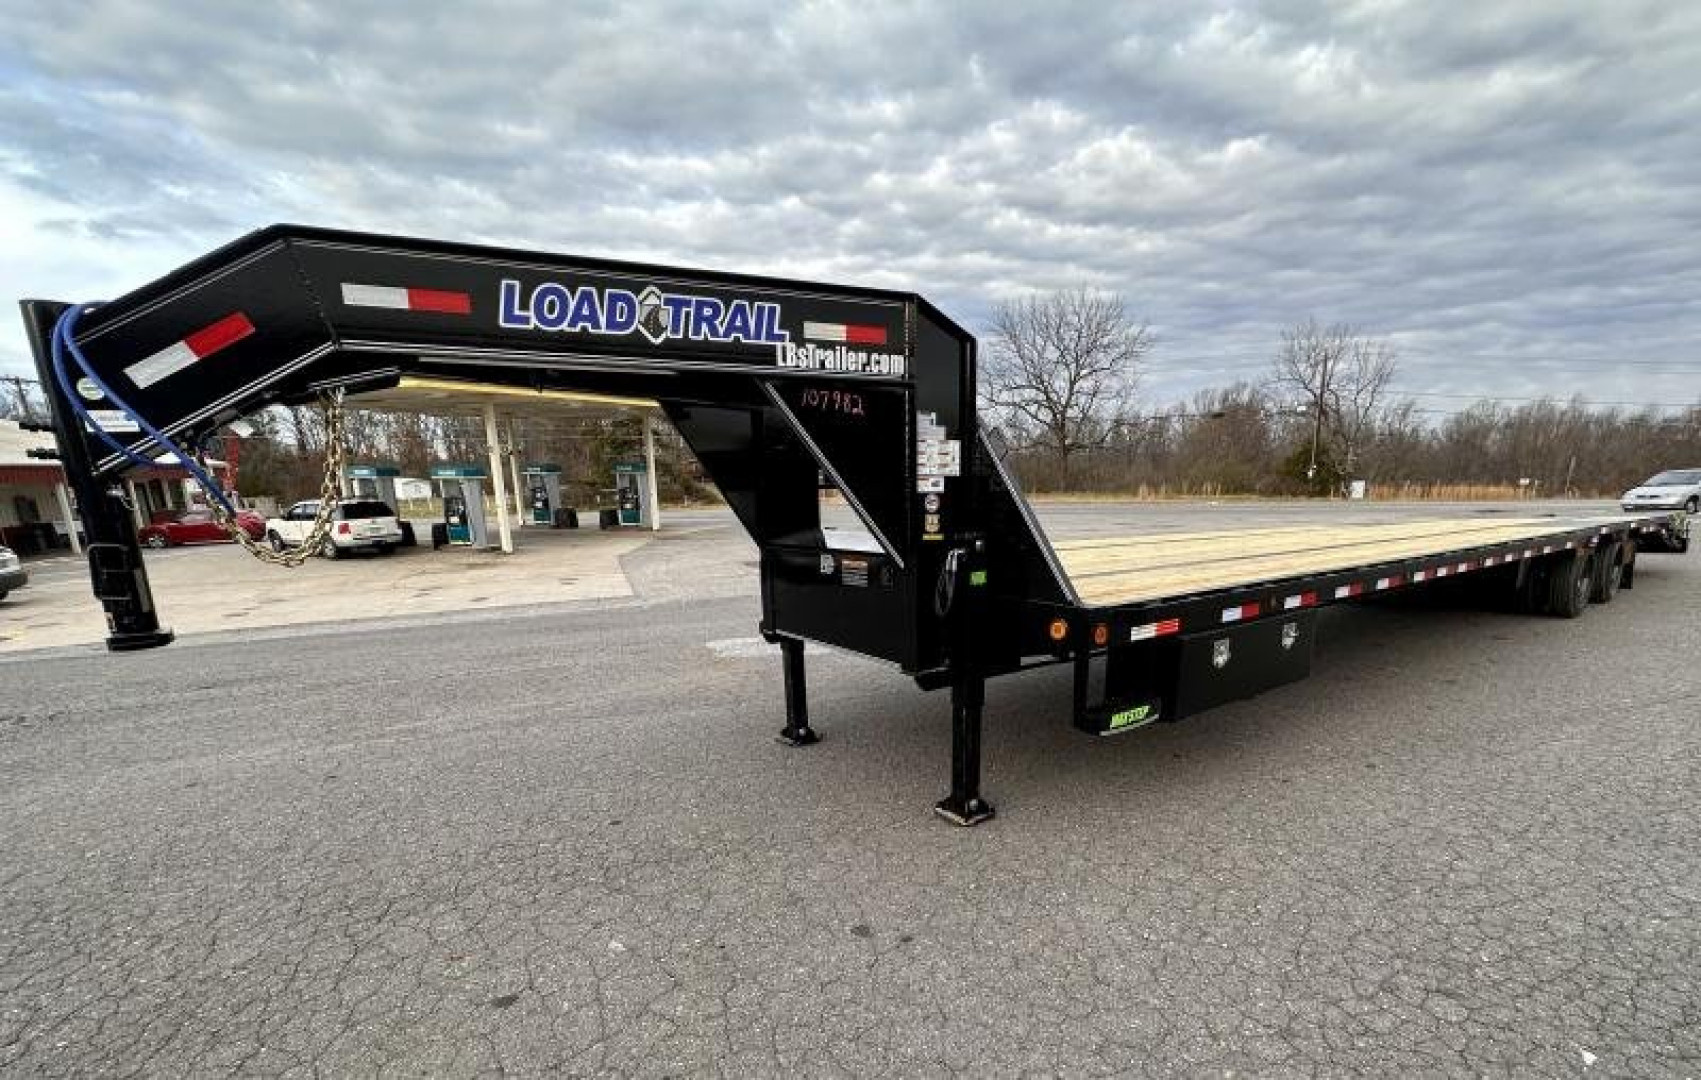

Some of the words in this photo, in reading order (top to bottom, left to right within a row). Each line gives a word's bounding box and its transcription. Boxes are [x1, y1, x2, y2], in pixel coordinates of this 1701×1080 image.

[499, 279, 638, 334] LOAD
[661, 293, 790, 344] TRAIL
[775, 342, 905, 375] LBsTrailer.com
